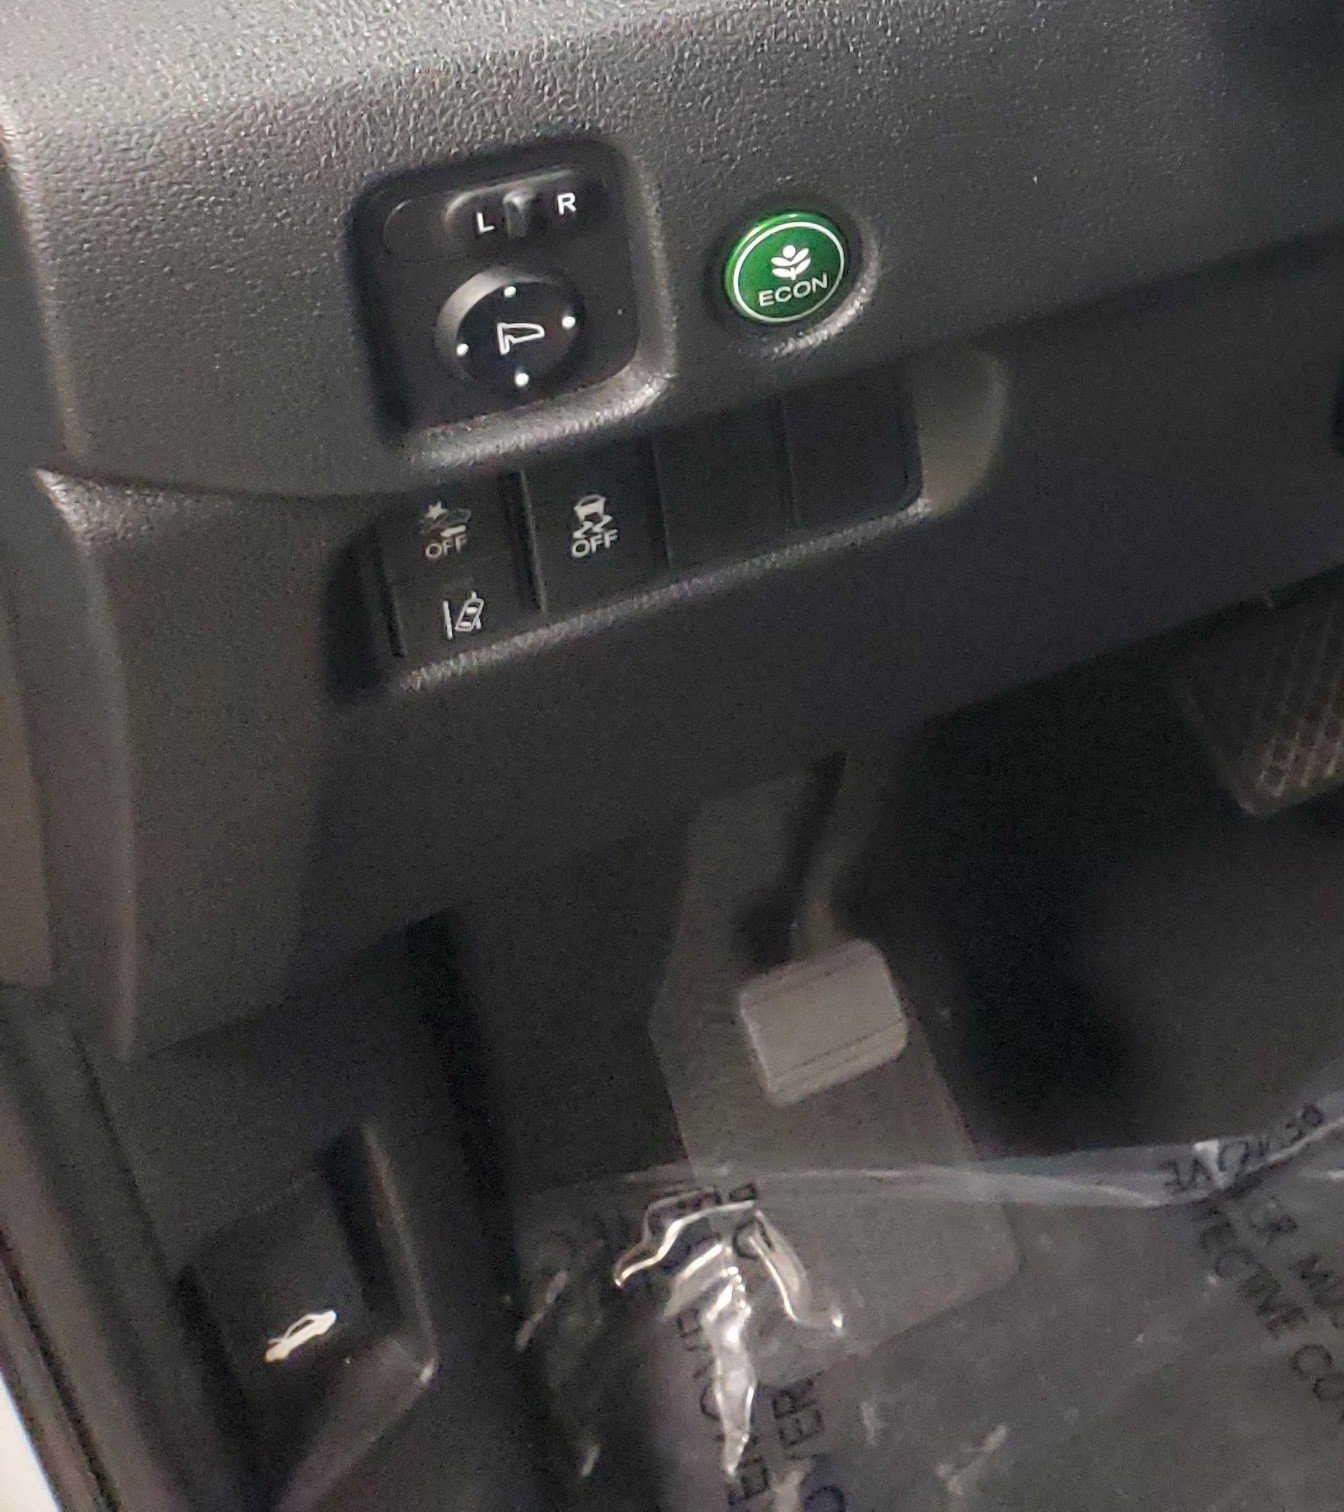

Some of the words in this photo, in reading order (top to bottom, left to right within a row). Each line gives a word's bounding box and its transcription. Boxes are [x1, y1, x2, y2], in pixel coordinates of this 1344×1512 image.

[557, 192, 577, 216] R
[477, 212, 495, 234] L
[758, 274, 829, 307] ECON
[424, 535, 468, 560] OFF
[571, 529, 619, 558] OFF
